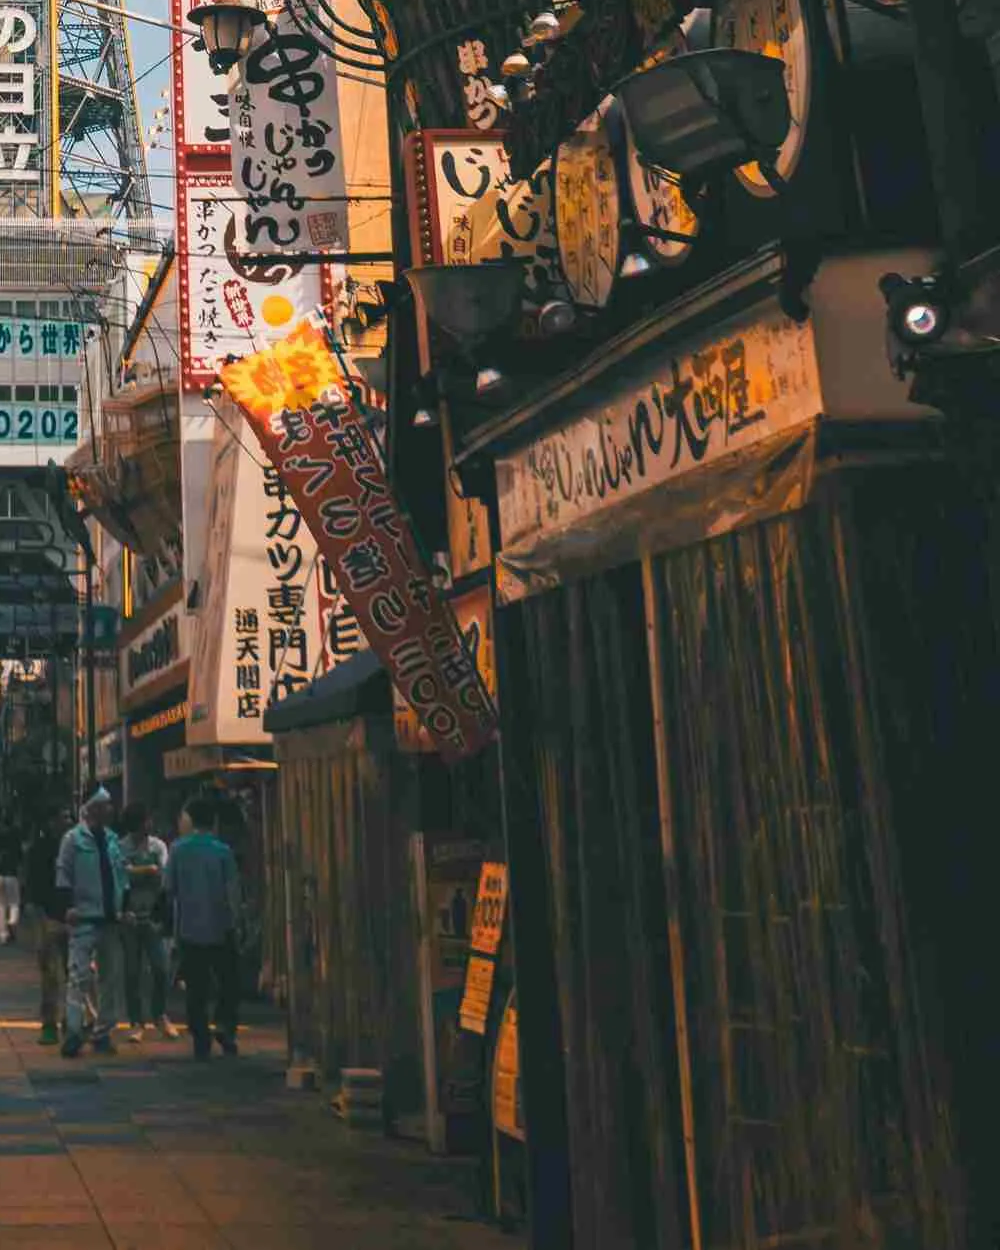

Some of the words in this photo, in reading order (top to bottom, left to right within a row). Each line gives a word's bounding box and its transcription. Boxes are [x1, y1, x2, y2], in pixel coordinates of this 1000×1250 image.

[246, 34, 335, 188] 串かつ
[196, 201, 217, 257] 串かつ
[198, 267, 222, 349] たこ焼き
[261, 466, 310, 705] 串カツ専門店
[234, 607, 261, 719] 通天閣店
